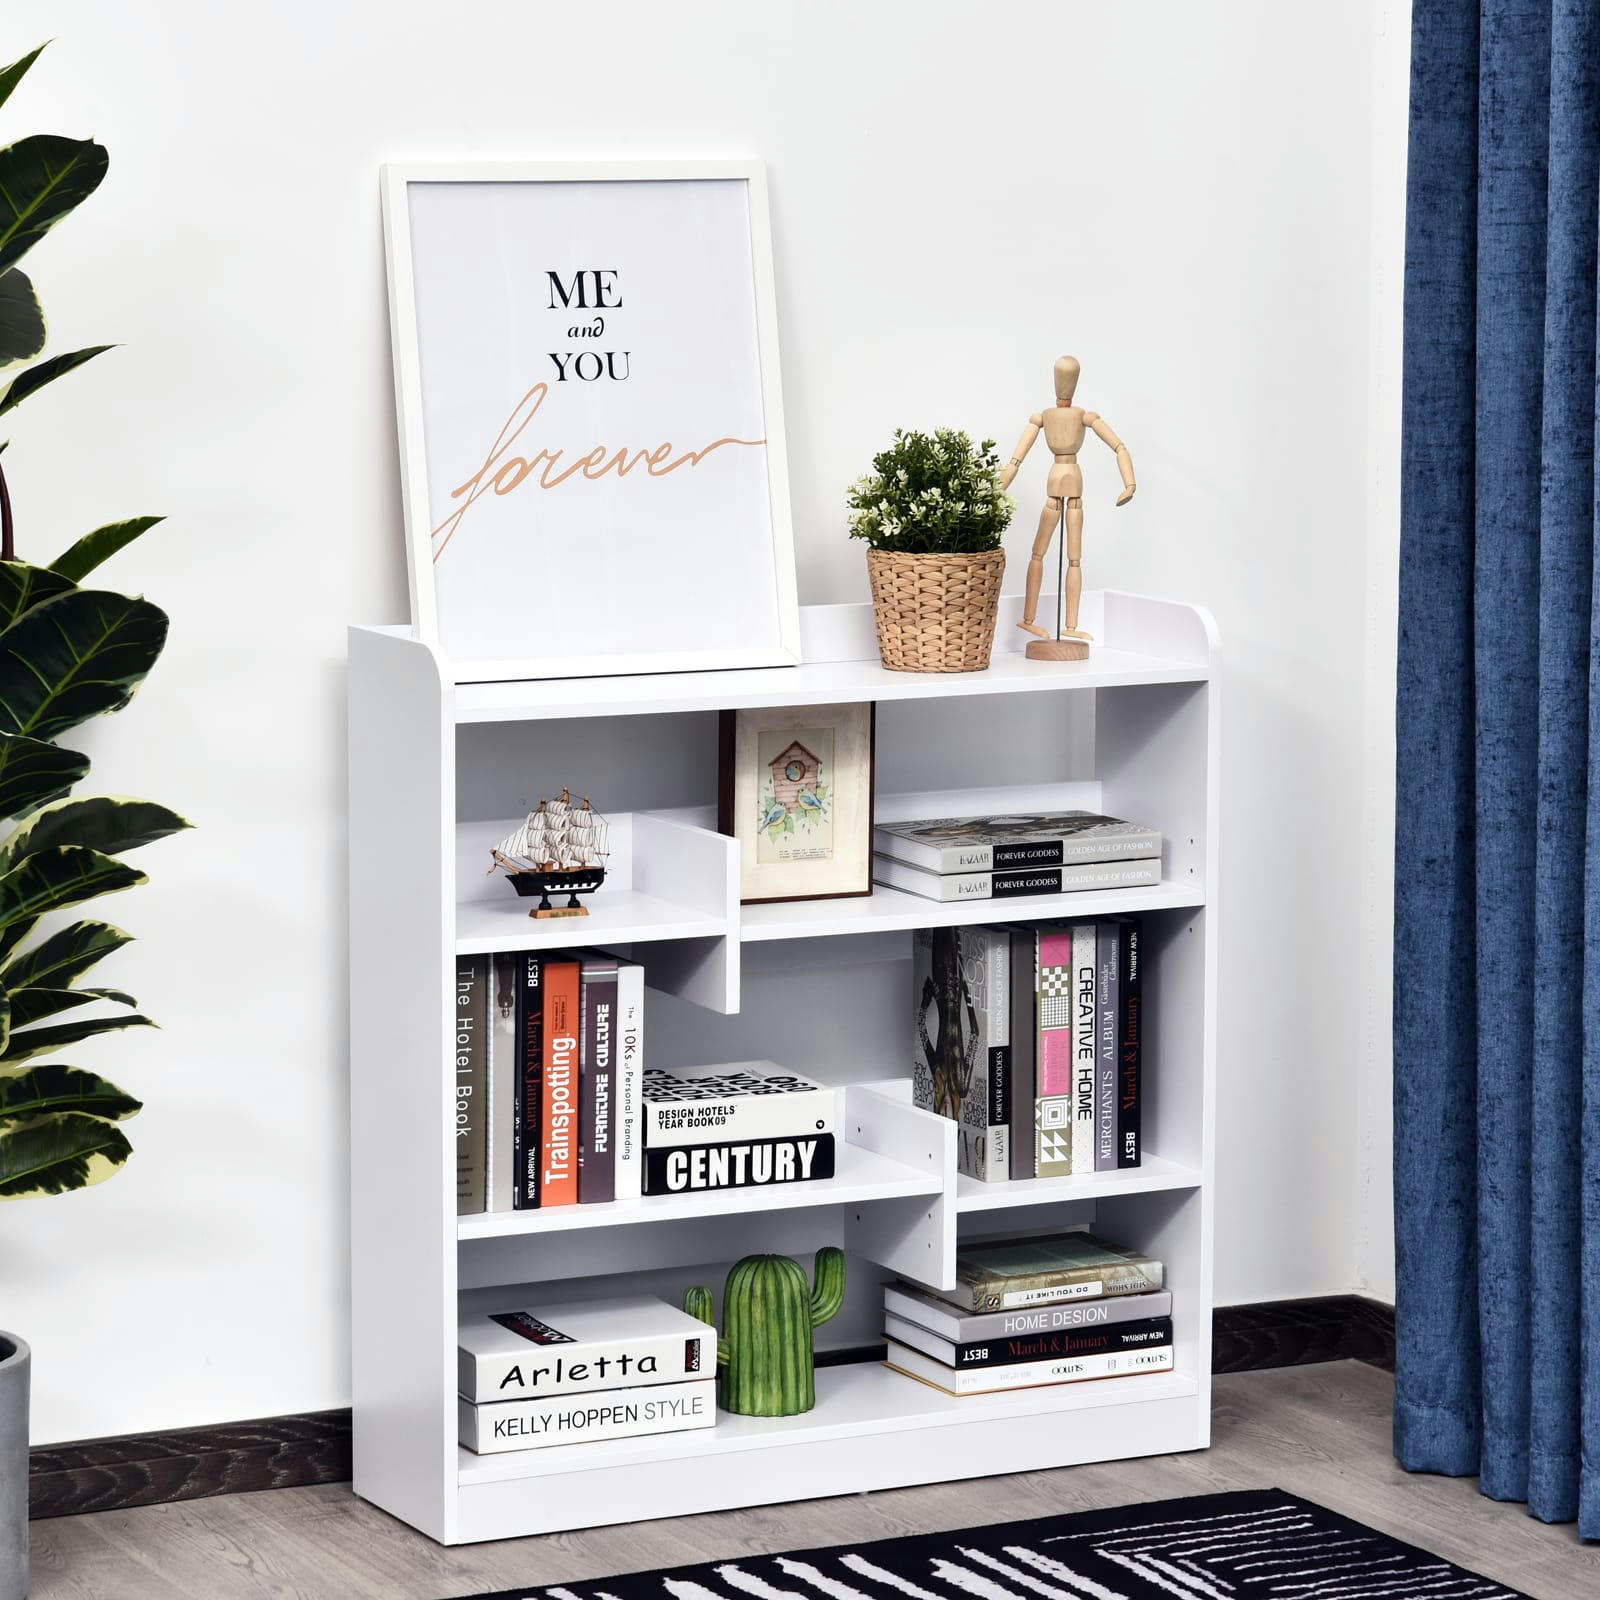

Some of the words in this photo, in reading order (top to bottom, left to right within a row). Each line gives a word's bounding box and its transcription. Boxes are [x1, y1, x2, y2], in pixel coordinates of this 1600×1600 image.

[544, 270, 623, 308] ME
[568, 316, 604, 338] and
[548, 352, 632, 382] YOU
[431, 382, 767, 565] forever
[996, 850, 1026, 861] FOREVER
[1027, 848, 1060, 858] GODDESS
[1068, 845, 1096, 855] GOLDEN
[1096, 844, 1110, 852] AGE
[1112, 842, 1122, 851] OF
[1123, 840, 1153, 850] FASHION
[995, 879, 1025, 890] FOREVER
[1026, 877, 1058, 888] GODDESS
[1066, 874, 1094, 884] GOLDEN
[1094, 872, 1109, 882] AGE
[1110, 872, 1121, 880] OF
[1121, 870, 1152, 880] FASHION
[528, 956, 538, 987] BEST
[995, 944, 1004, 977] FASHION
[458, 968, 474, 1006] The
[995, 979, 1004, 989] OF
[995, 992, 1004, 1006] AGE
[995, 1008, 1004, 1041] GOLDEN
[1078, 968, 1094, 1060] CREATIVE
[1123, 996, 1138, 1048] January
[457, 1018, 474, 1074] Hotel
[528, 1011, 542, 1054] March
[596, 1004, 610, 1068] CULTURE
[624, 1028, 636, 1060] 10Ks
[1103, 1010, 1114, 1060] ALBUM
[528, 1060, 540, 1072] &
[994, 1051, 1004, 1088] GODDESS
[1124, 1052, 1136, 1062] &
[624, 1072, 634, 1114] Personal
[686, 1078, 748, 1098] YEAR
[714, 1073, 784, 1095] BOOK
[1078, 1068, 1093, 1120] HOME
[1123, 1066, 1137, 1110] March
[456, 1085, 473, 1137] Book
[527, 1078, 541, 1131] January
[595, 1074, 608, 1152] FURNITURE
[658, 1108, 694, 1120] DESIGN
[994, 1090, 1004, 1122] FOREVER
[1101, 1070, 1113, 1159] MERCHANTS
[622, 1118, 634, 1160] Branding
[658, 1118, 684, 1130] YEAR
[1126, 1132, 1135, 1160] BEST
[528, 1146, 536, 1180] ARRIVAL
[666, 1140, 818, 1192] CENTURY
[1025, 1292, 1034, 1300] IT
[1005, 1316, 1048, 1333] HOME
[1052, 1306, 1108, 1326] DESION
[1150, 1331, 1164, 1340] NEW
[962, 1348, 989, 1362] BEST
[1008, 1340, 1048, 1356] March
[1050, 1338, 1062, 1351] &
[1064, 1334, 1110, 1352] January
[1121, 1333, 1148, 1344] ARRIVAL
[500, 1354, 658, 1390] Arletta
[494, 1414, 552, 1438] KELLY
[558, 1404, 638, 1431] HOPPEN
[644, 1396, 704, 1420] STYLE
